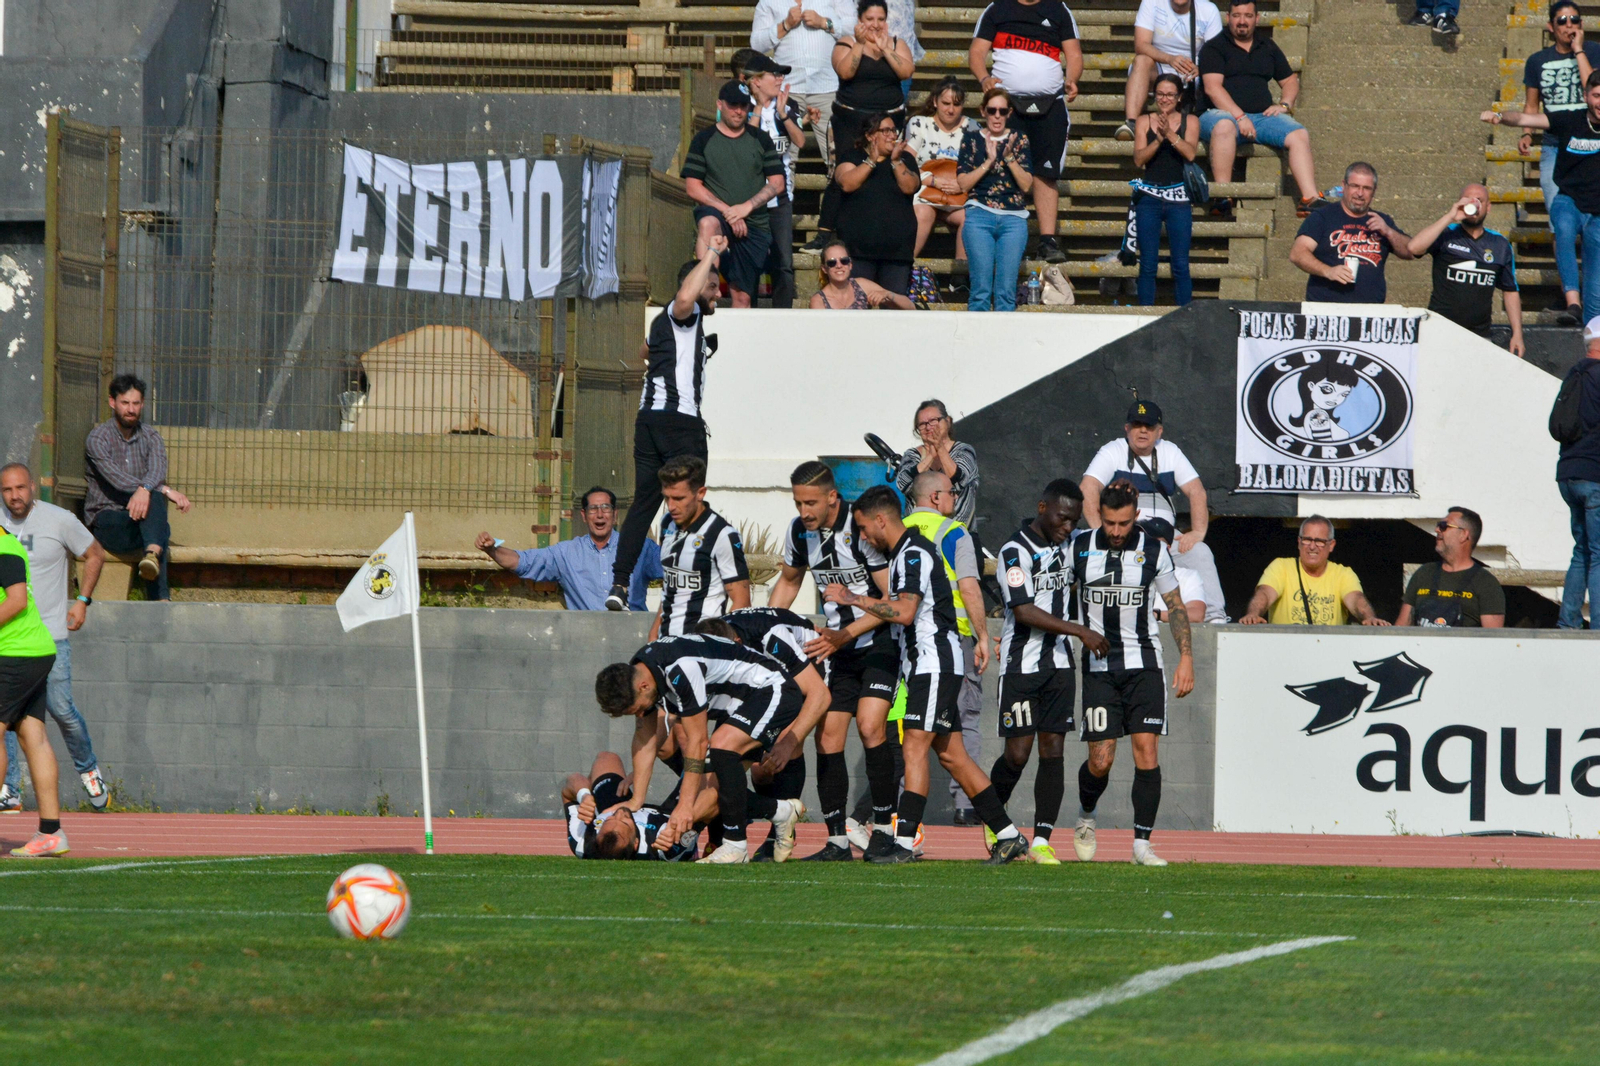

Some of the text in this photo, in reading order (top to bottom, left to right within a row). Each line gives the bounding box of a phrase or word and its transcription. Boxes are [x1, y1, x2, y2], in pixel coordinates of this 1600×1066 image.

[1004, 35, 1051, 56] ADIDAS
[331, 142, 564, 301] ETERNO
[1329, 229, 1367, 247] Jack
[1446, 267, 1496, 286] LOTUS
[1239, 311, 1417, 345] POCAS PERO LOCAS
[1275, 433, 1384, 459] GIRLS
[1238, 464, 1411, 494] BALONADICTAS
[1083, 587, 1143, 607] LOTUS
[869, 683, 892, 693] LEGEA
[1011, 700, 1033, 728] 11
[1085, 706, 1108, 733] 10
[1356, 722, 1600, 822] aqua
